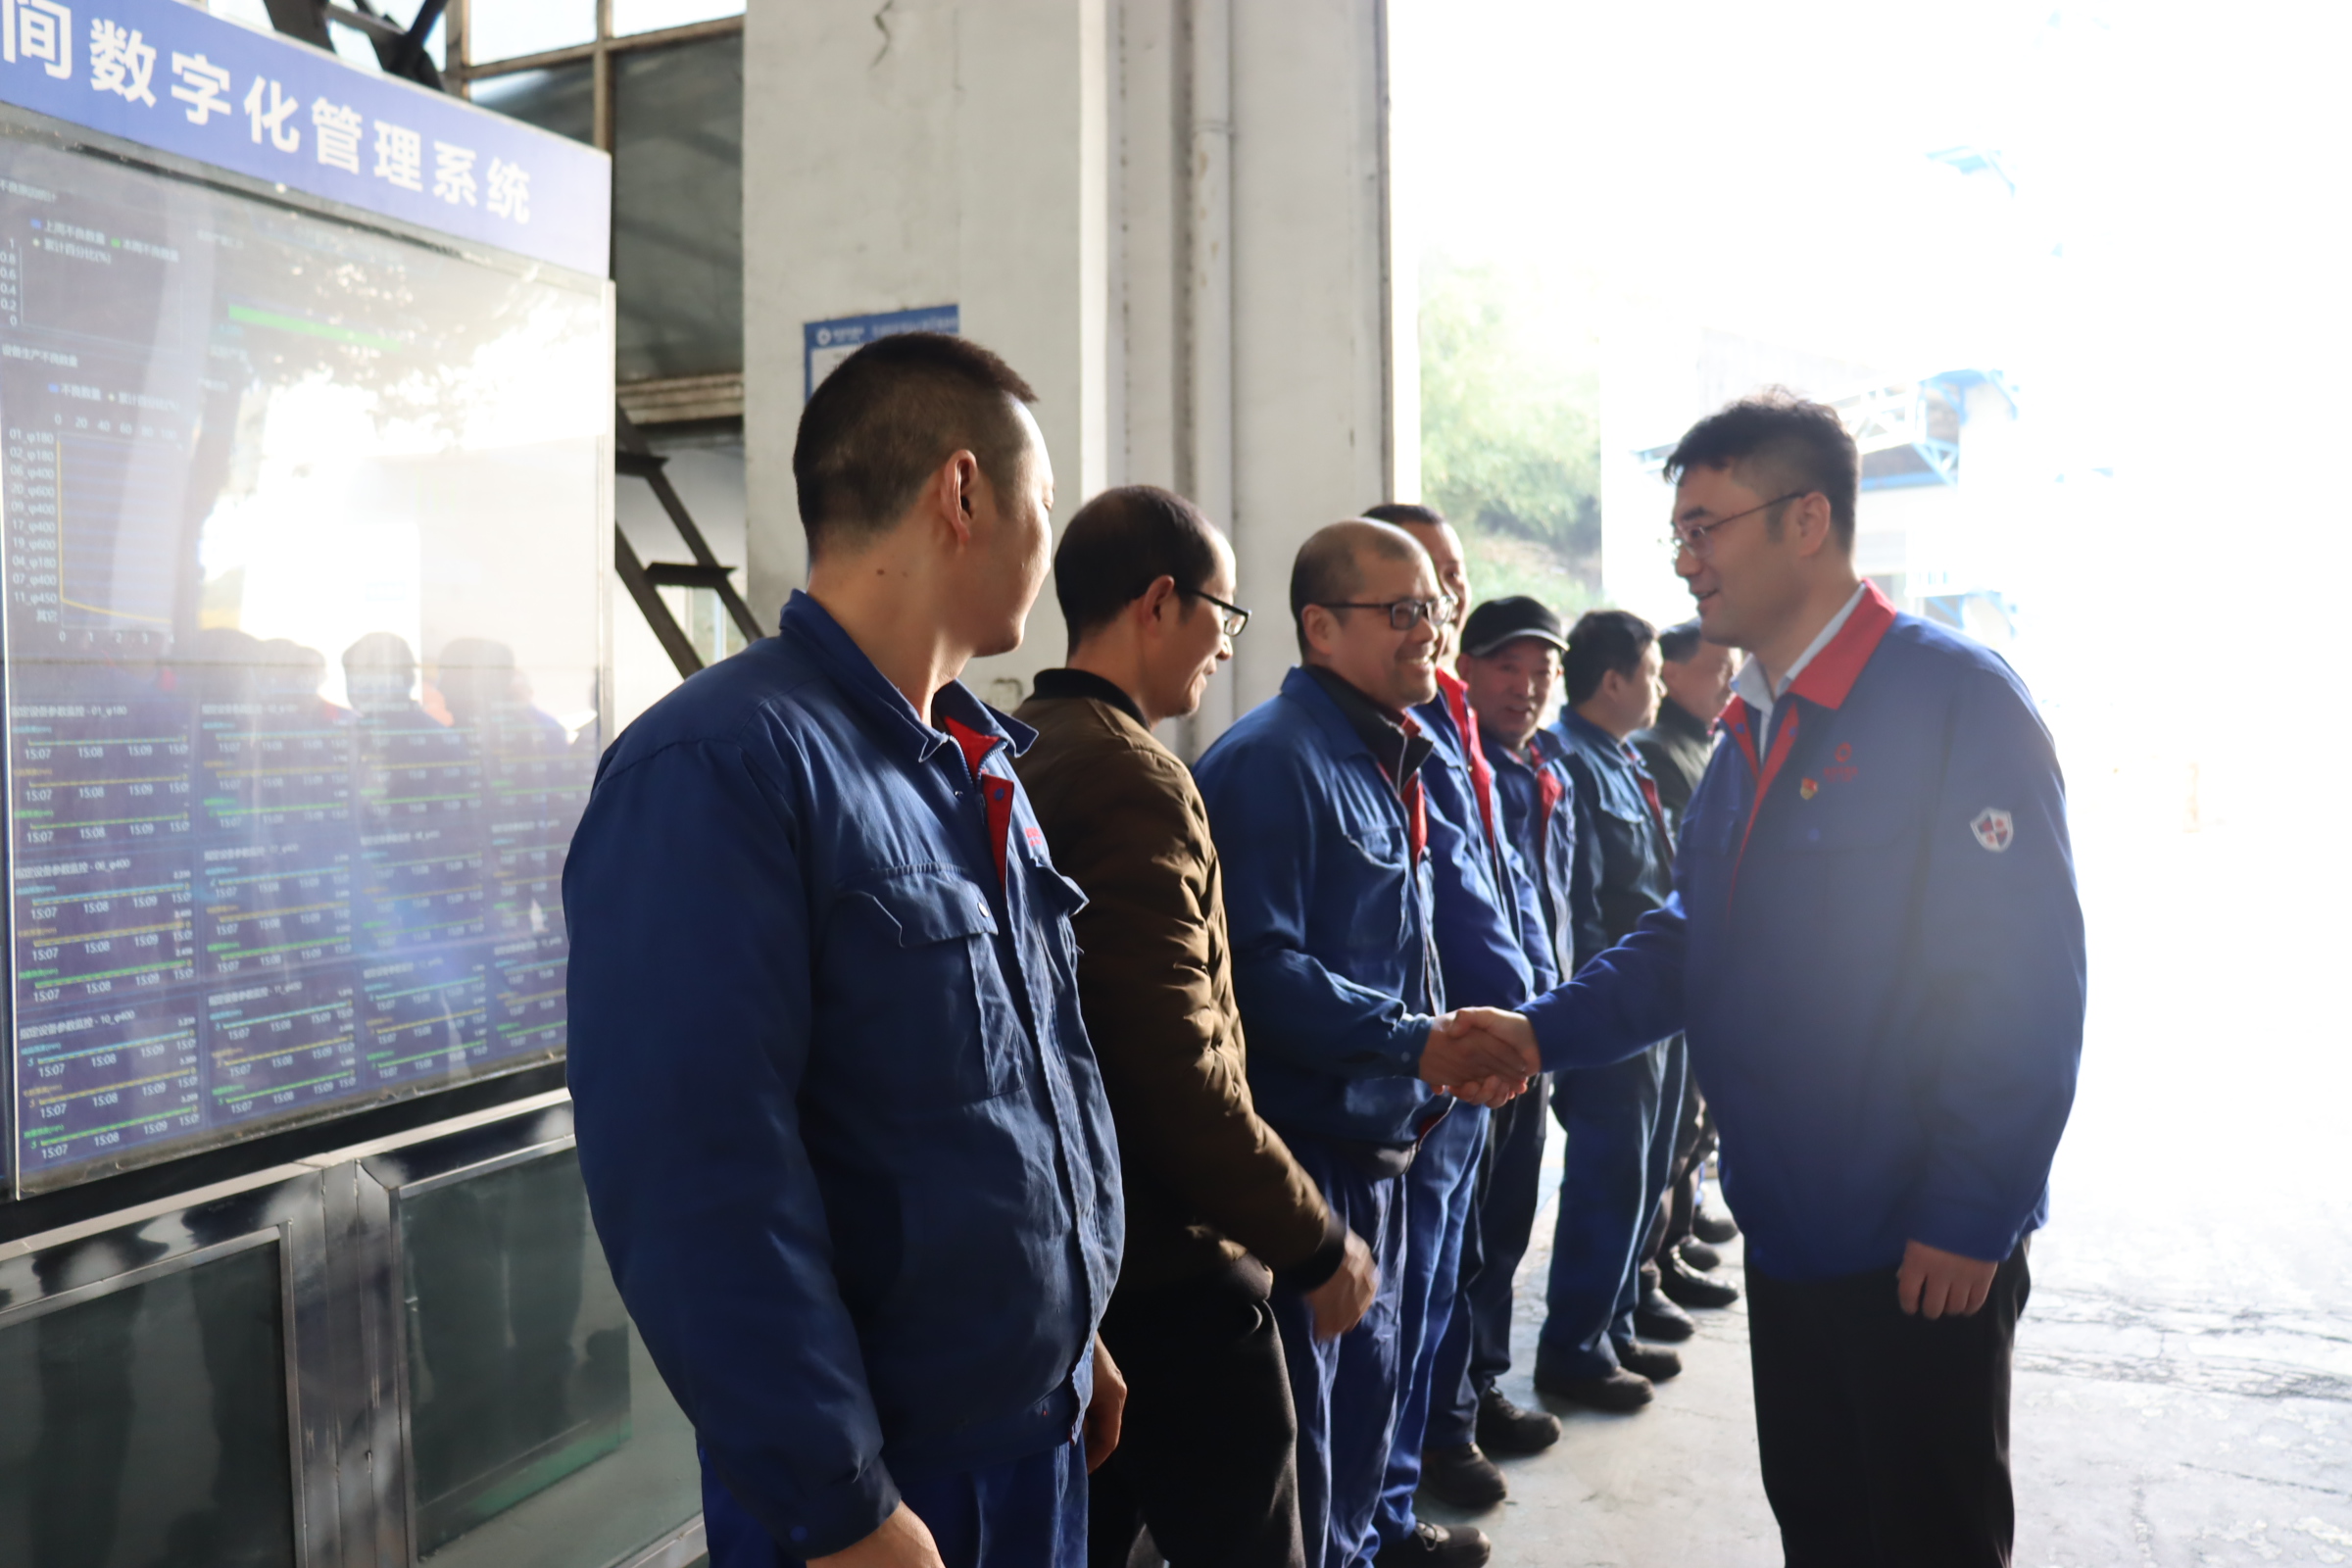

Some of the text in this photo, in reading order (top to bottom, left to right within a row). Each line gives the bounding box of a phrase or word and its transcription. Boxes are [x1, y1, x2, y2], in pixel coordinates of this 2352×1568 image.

[1, 0, 530, 224] 间数字化管理系统
[0, 298, 17, 312] 0.2
